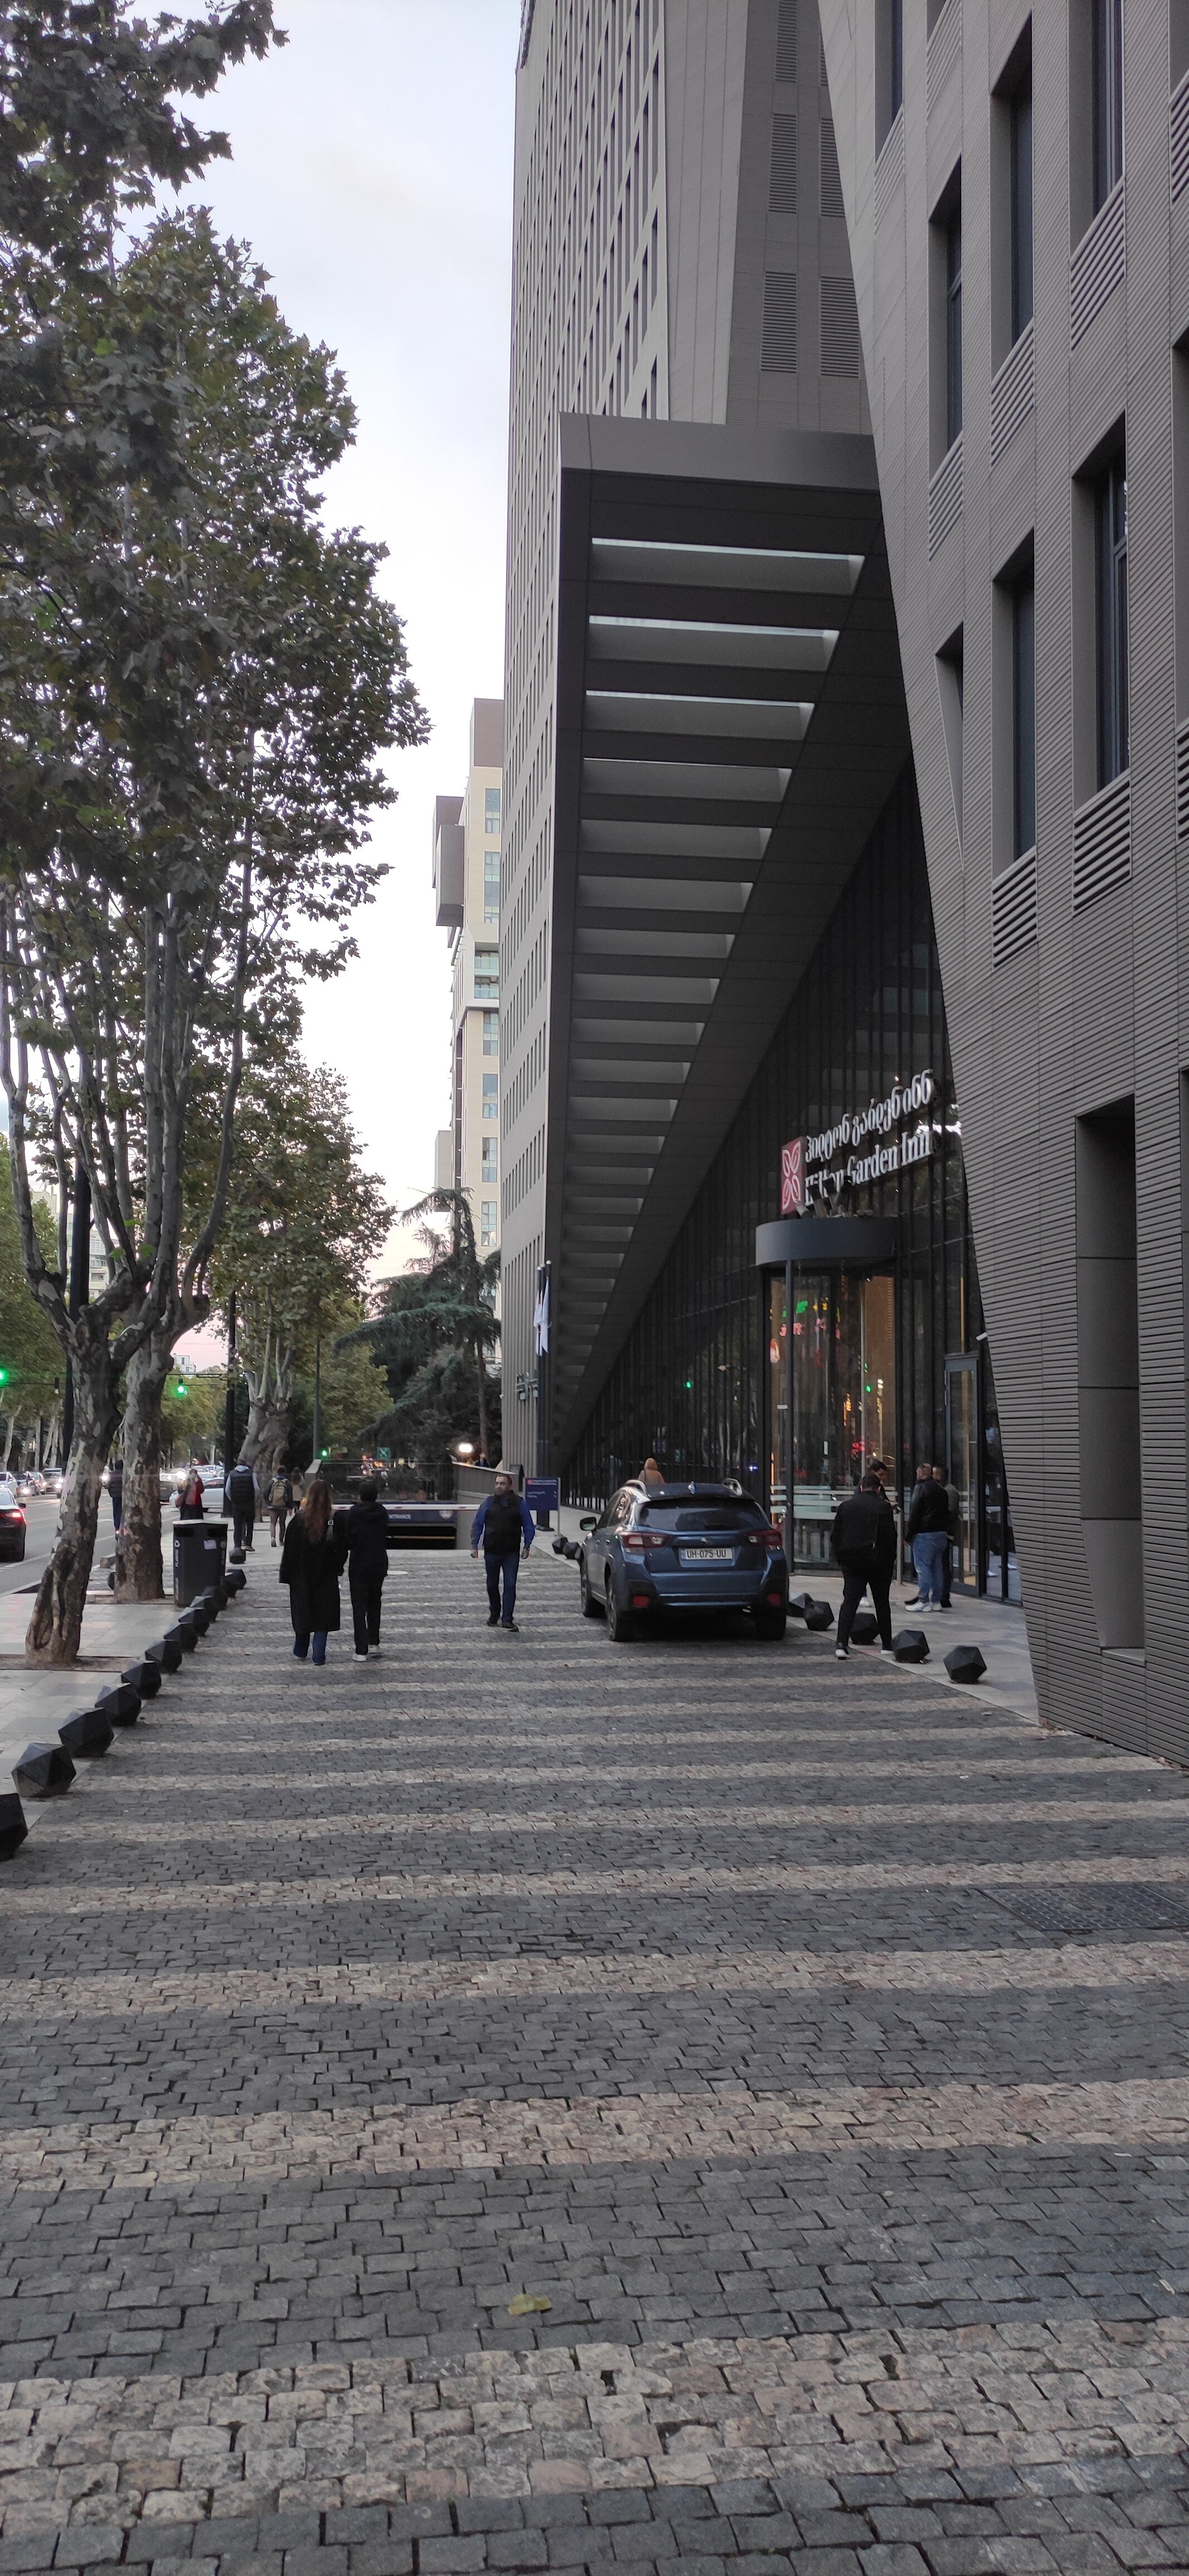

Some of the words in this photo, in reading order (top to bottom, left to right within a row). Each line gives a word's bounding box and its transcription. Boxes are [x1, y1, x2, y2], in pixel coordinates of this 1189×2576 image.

[852, 1085, 903, 1146] გარდენ
[903, 1069, 933, 1114] ინნ
[847, 1144, 898, 1186] Garden
[901, 1130, 932, 1166] Inn
